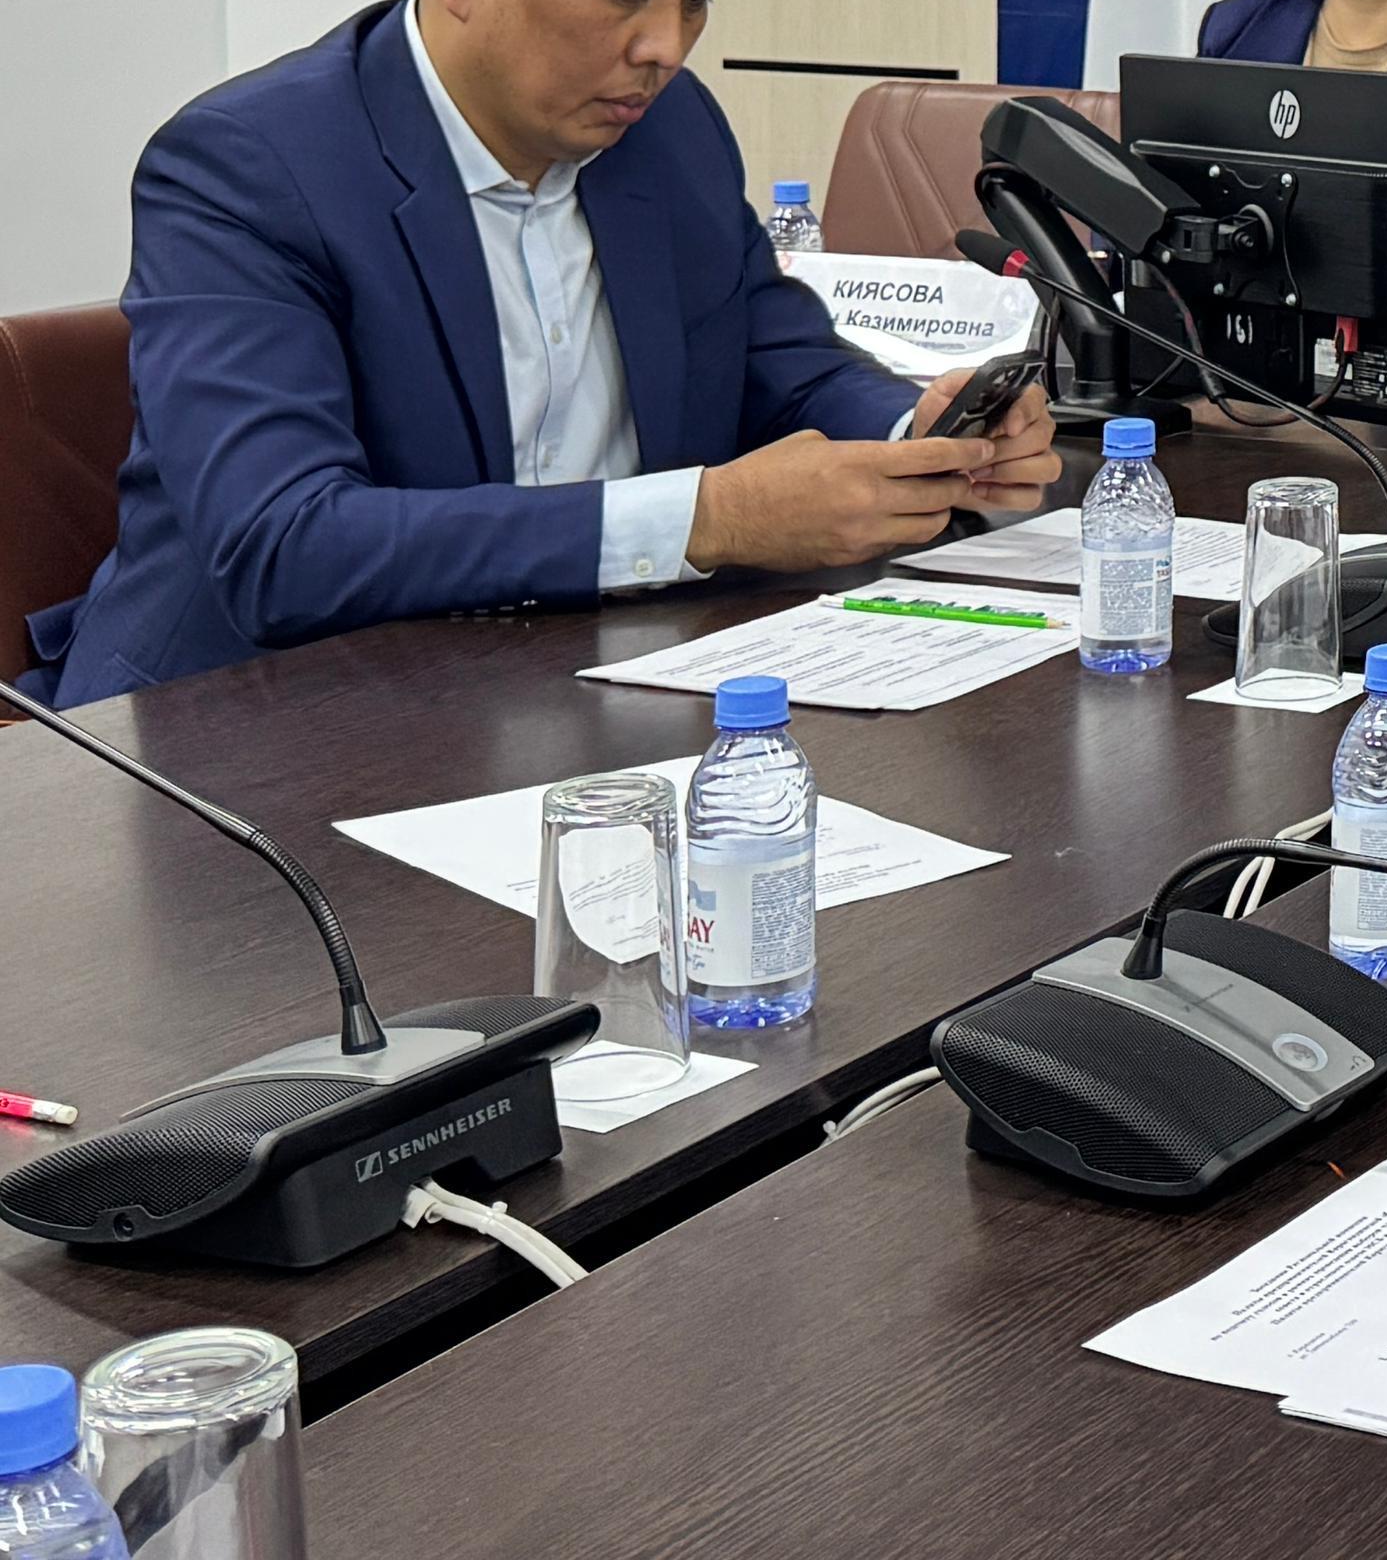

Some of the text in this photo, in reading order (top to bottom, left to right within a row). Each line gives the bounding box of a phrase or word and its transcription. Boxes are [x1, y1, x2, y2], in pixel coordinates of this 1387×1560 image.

[1274, 93, 1297, 134] hp
[833, 279, 944, 305] КИЯСОВА
[847, 309, 995, 338] Казимировна
[387, 1097, 513, 1165] SENNHEISER
